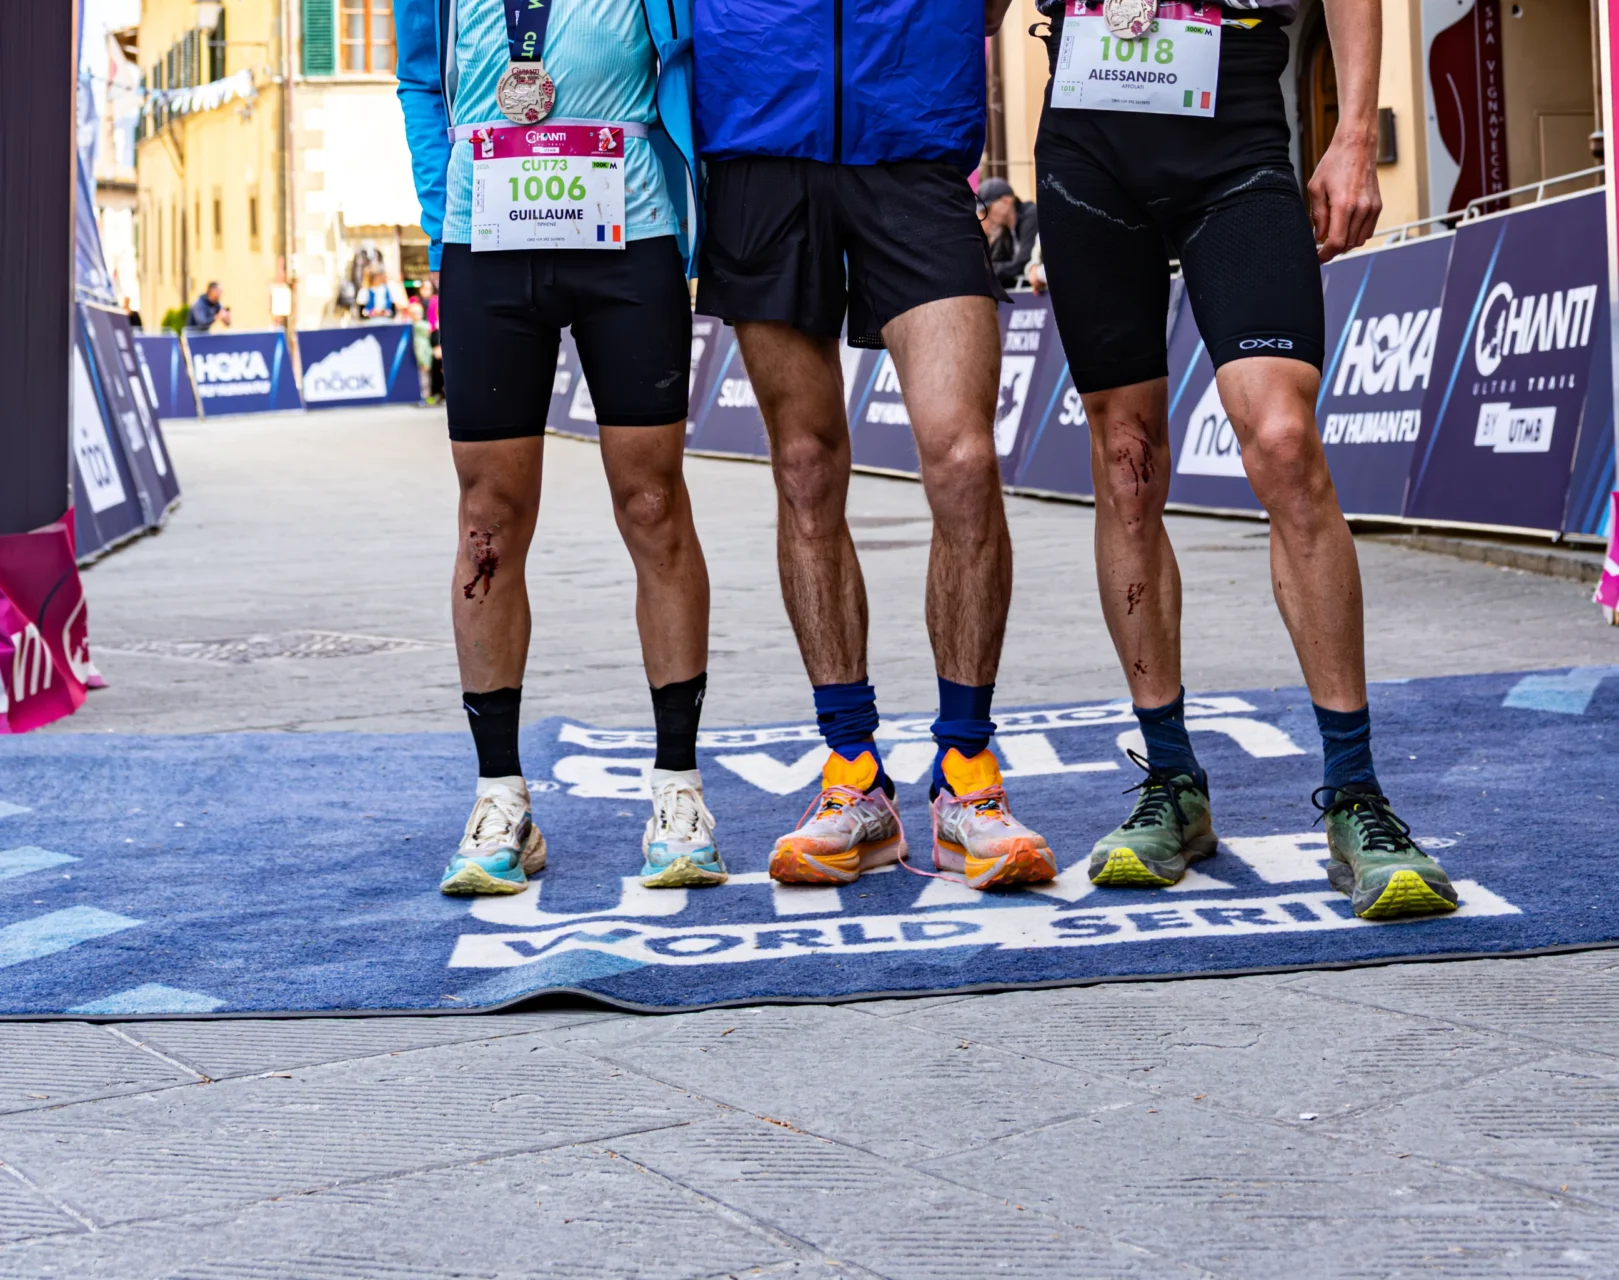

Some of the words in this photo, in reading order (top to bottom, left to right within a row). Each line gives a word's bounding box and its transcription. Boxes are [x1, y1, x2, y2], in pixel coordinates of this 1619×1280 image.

[1204, 28, 1213, 37] M
[1484, 6, 1495, 45] SPA
[521, 31, 537, 59] CUT
[1099, 35, 1174, 65] 1018
[1088, 68, 1178, 85] ALESSANDRO
[1486, 60, 1503, 214] VIGNAVECCHI
[521, 159, 568, 172] CUT73
[609, 162, 618, 170] M
[508, 175, 587, 202] 1006
[509, 208, 584, 222] GUILLAUME
[478, 228, 493, 236] 1006
[1475, 282, 1598, 377] CHIANTI
[193, 350, 270, 383] HOKA
[1332, 307, 1442, 397] HOKA
[1472, 378, 1516, 396] ULTRA
[1528, 373, 1576, 393] TRAIL
[1322, 413, 1347, 445] FLY
[1344, 411, 1399, 444] HUMAN
[1481, 411, 1499, 437] BY
[1507, 416, 1543, 444] UTMB
[503, 919, 984, 959] WORLD
[1050, 897, 1358, 941] SERI
